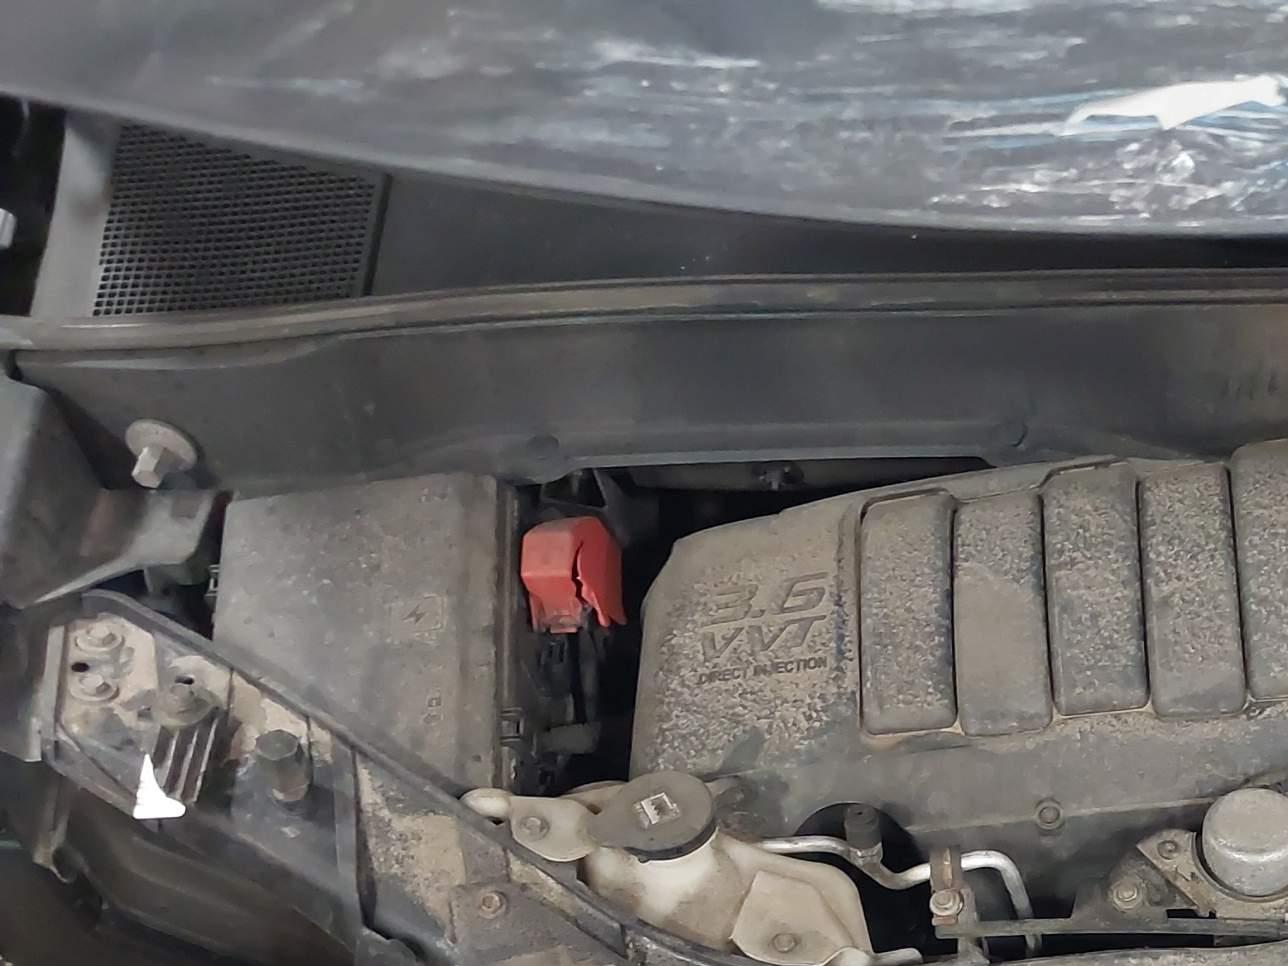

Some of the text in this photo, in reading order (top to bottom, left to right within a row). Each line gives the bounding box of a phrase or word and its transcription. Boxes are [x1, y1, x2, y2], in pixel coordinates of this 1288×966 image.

[700, 571, 829, 628] 3.6
[701, 614, 827, 663] VVT
[696, 655, 828, 686] DIRECT INJECTION
